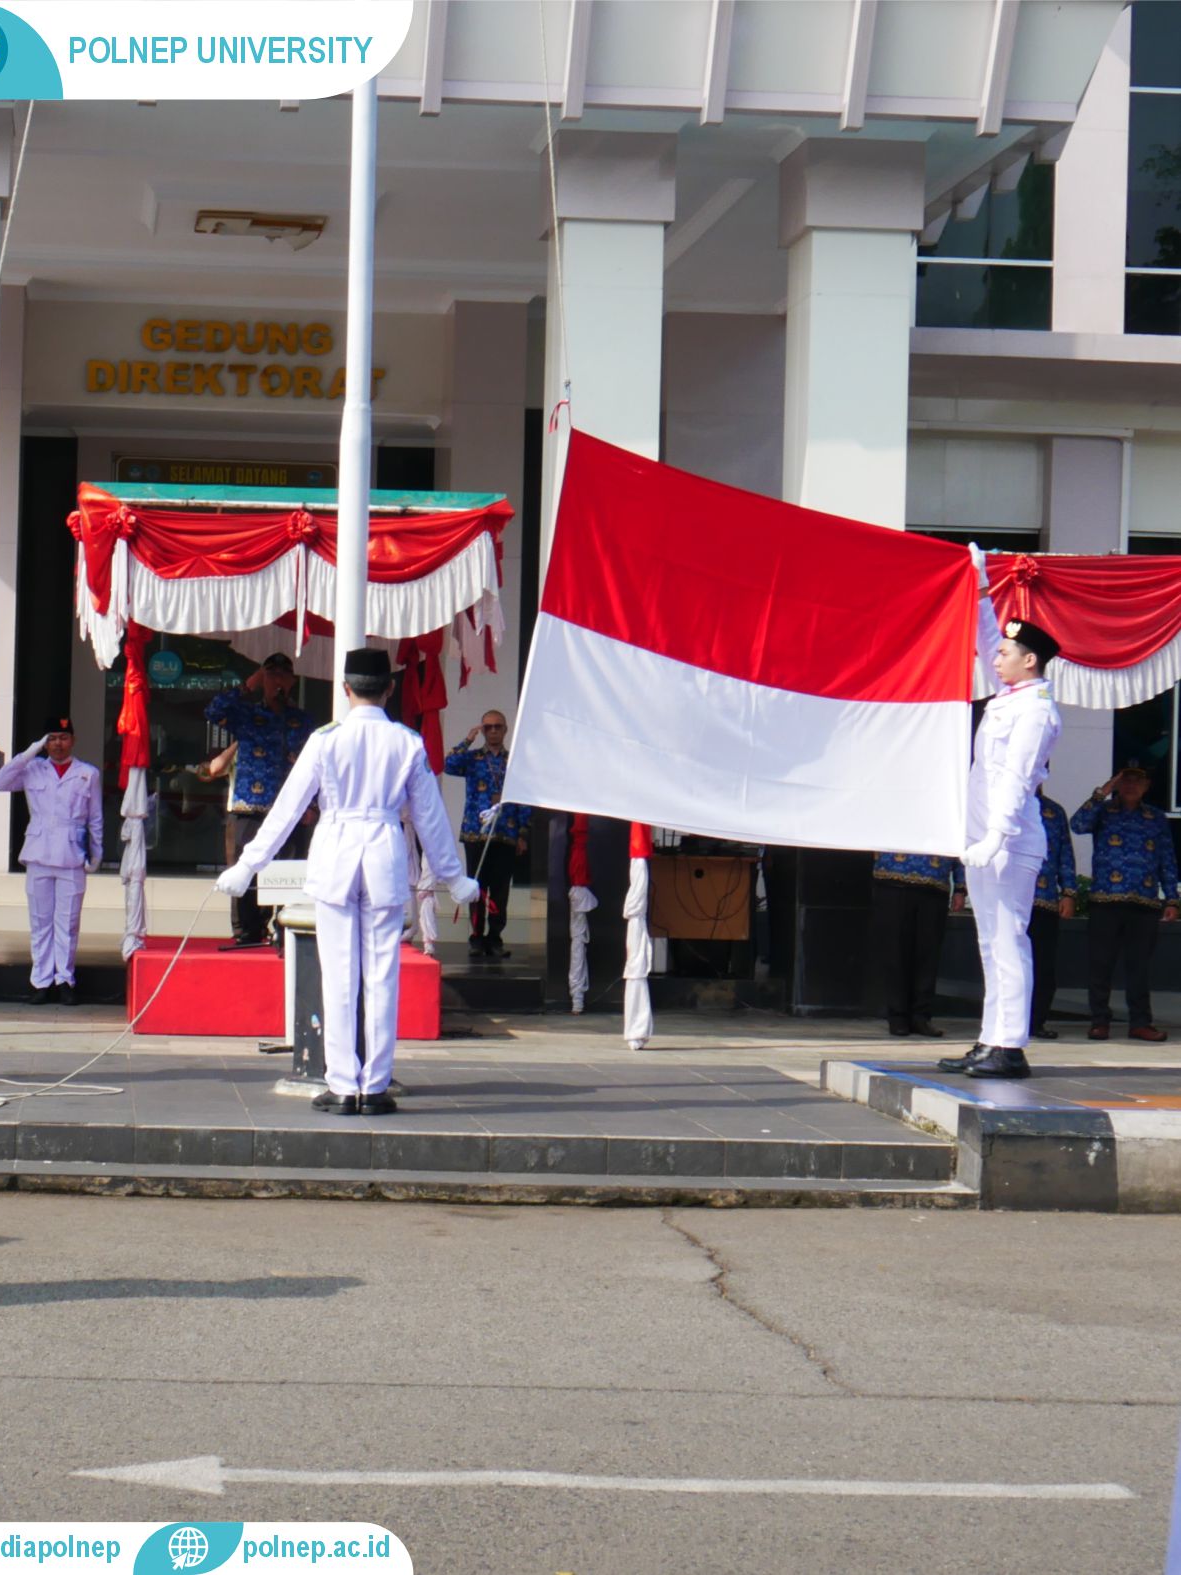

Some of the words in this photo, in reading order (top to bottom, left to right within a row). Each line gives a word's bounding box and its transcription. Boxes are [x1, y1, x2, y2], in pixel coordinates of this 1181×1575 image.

[141, 319, 334, 356] GEDUNG
[170, 465, 231, 483] SELAMAT
[235, 467, 287, 485] DATANG
